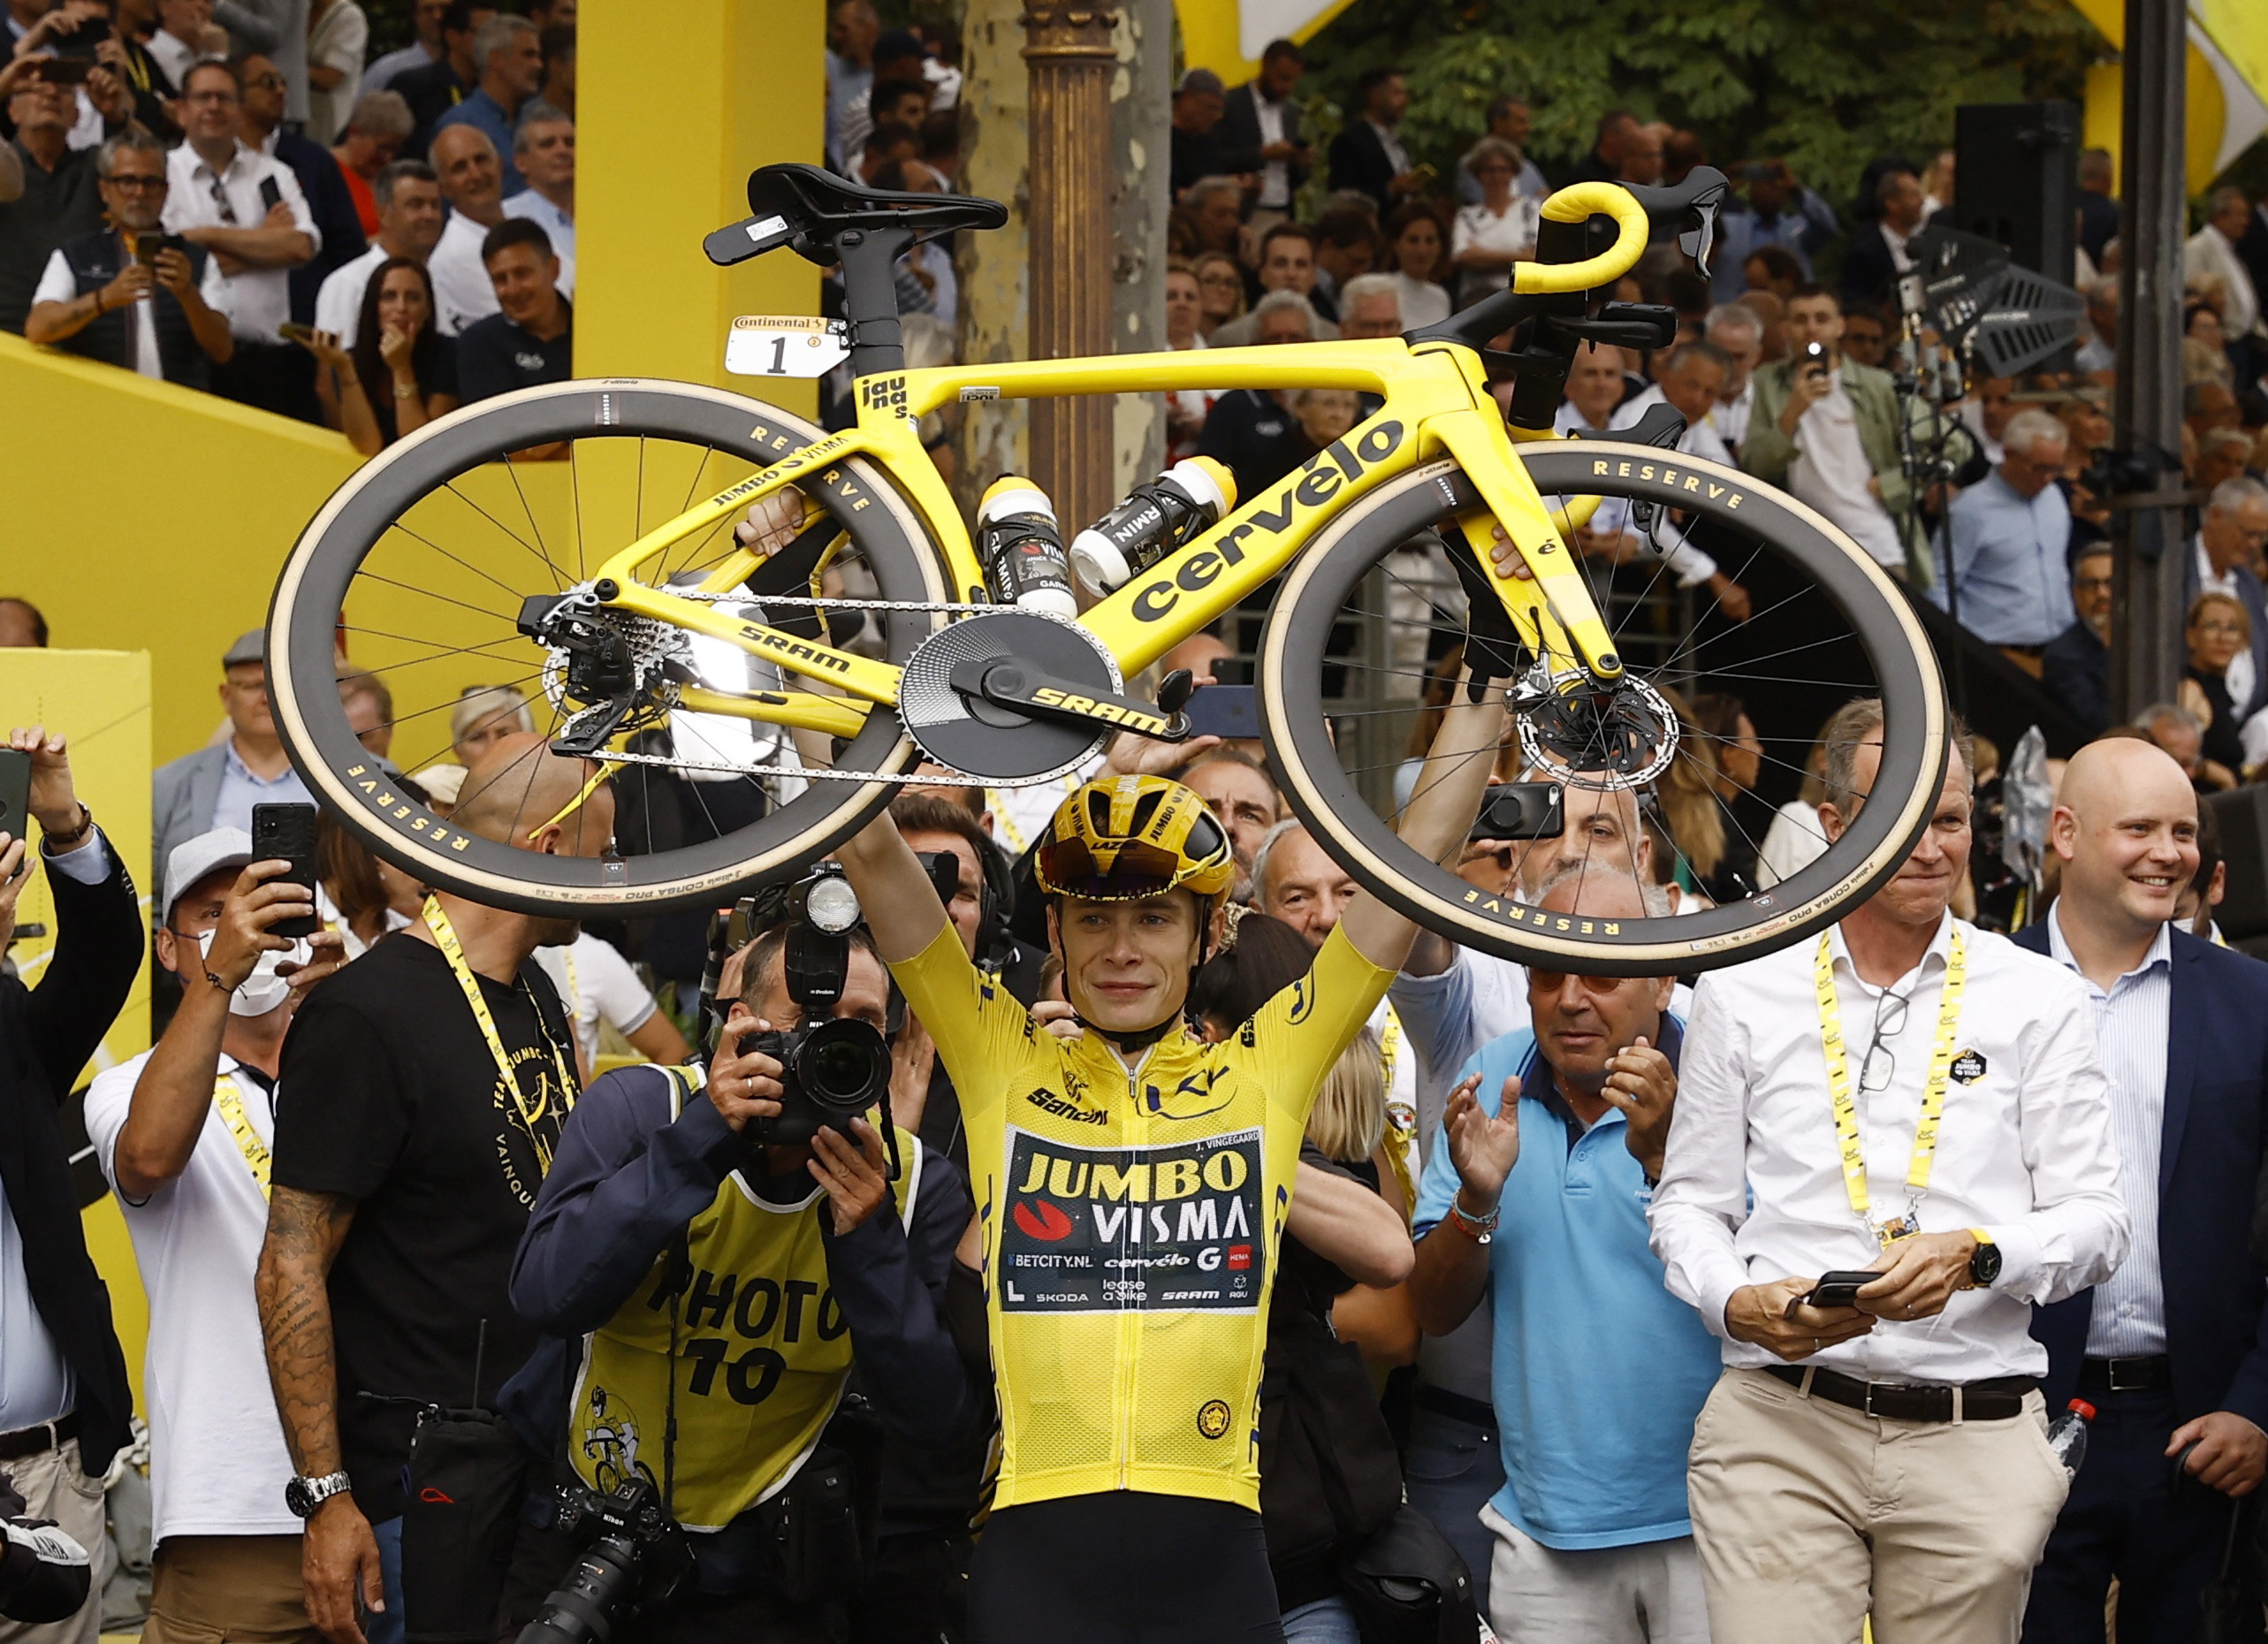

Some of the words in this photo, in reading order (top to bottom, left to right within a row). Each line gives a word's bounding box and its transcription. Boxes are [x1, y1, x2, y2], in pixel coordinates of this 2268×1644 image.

[734, 316, 810, 329] Continental
[766, 336, 787, 375] 1
[712, 469, 780, 507] JUMBO
[801, 436, 849, 460] VISMA
[749, 424, 871, 513] RERVE
[1593, 460, 1745, 511] RESERVE
[1131, 419, 1404, 623] cervélo
[1039, 580, 1071, 590] GARM
[738, 625, 850, 674] SRAM
[1031, 687, 1166, 735] SRAM
[347, 765, 470, 851] RESERVE
[1149, 805, 1176, 842] JUMBO
[625, 890, 655, 901] PRO
[658, 881, 704, 896] CORSA
[1814, 882, 1851, 910] CORSA
[1464, 890, 1619, 935] RESERVE
[1788, 907, 1813, 923] PRO
[1206, 1131, 1260, 1149] VINGEGAARD
[1018, 1150, 1248, 1203] JUMBO
[1091, 1195, 1251, 1244] VISMA
[1016, 1254, 1094, 1267] BETCITY.NL
[1104, 1253, 1191, 1268] cervélo
[1197, 1246, 1222, 1271] G
[1102, 1279, 1145, 1290] lease
[1161, 1290, 1220, 1300] SRAM
[1229, 1290, 1248, 1299] AGU
[647, 1268, 850, 1343] HOTO
[681, 1337, 788, 1406] 10
[602, 1512, 625, 1527] Nikon
